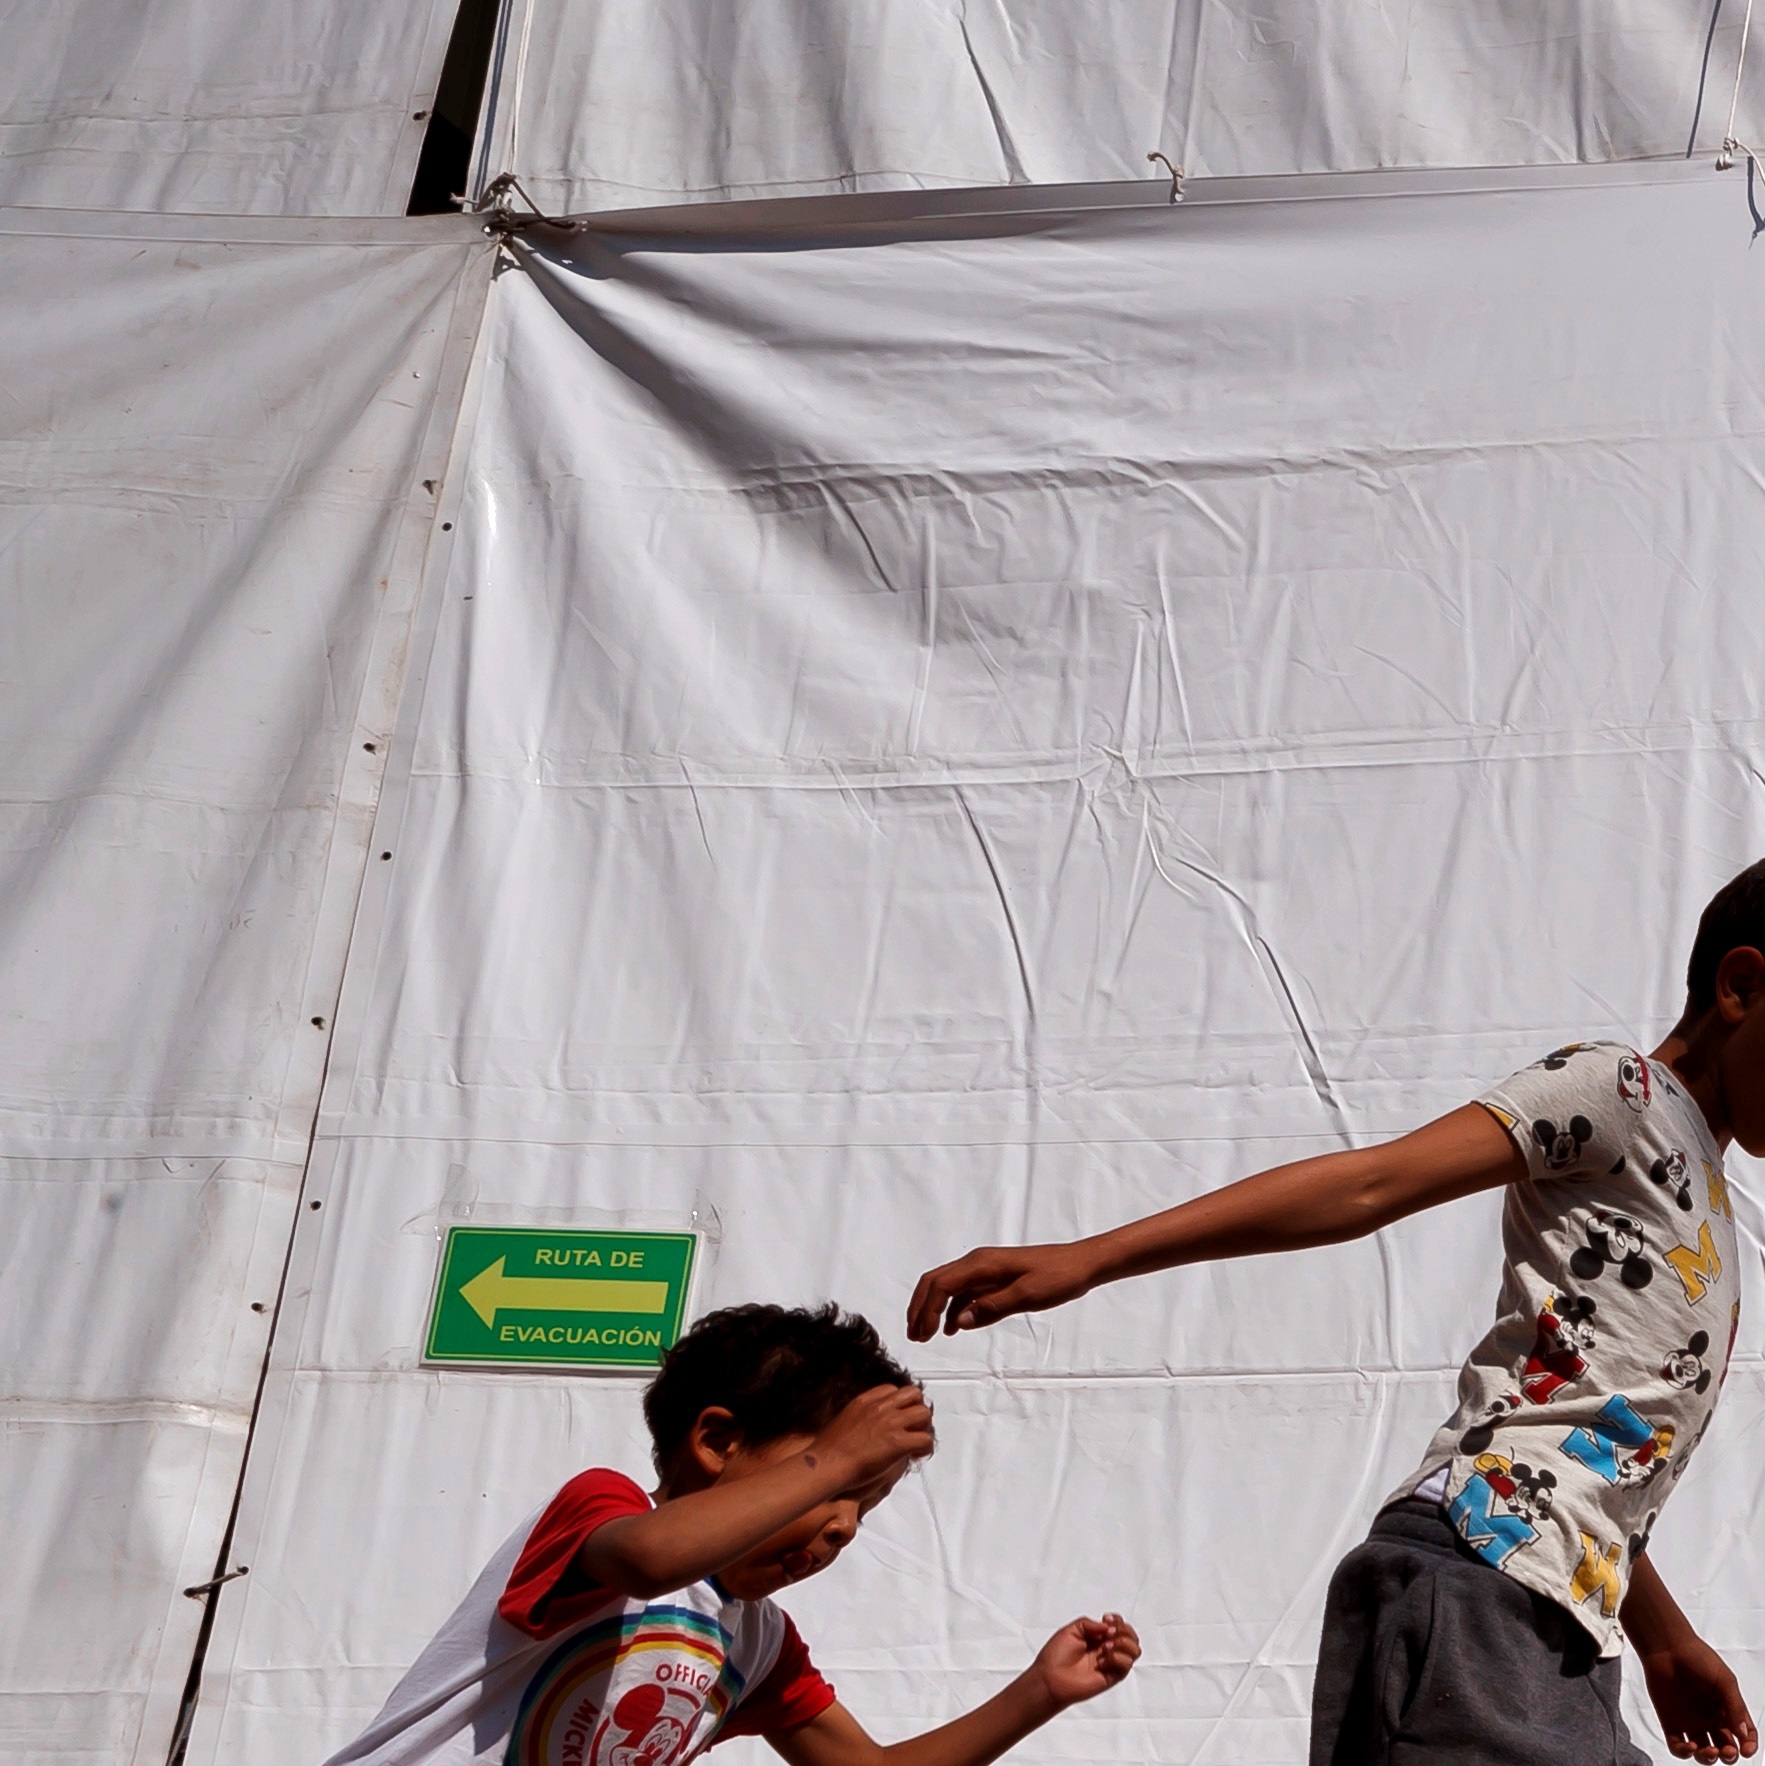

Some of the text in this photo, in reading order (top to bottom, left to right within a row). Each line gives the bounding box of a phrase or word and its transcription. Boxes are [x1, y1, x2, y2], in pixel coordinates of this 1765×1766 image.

[535, 1249, 644, 1268] RUTA DE
[1662, 1220, 1722, 1306] M
[500, 1325, 662, 1347] EVACUACIÓN
